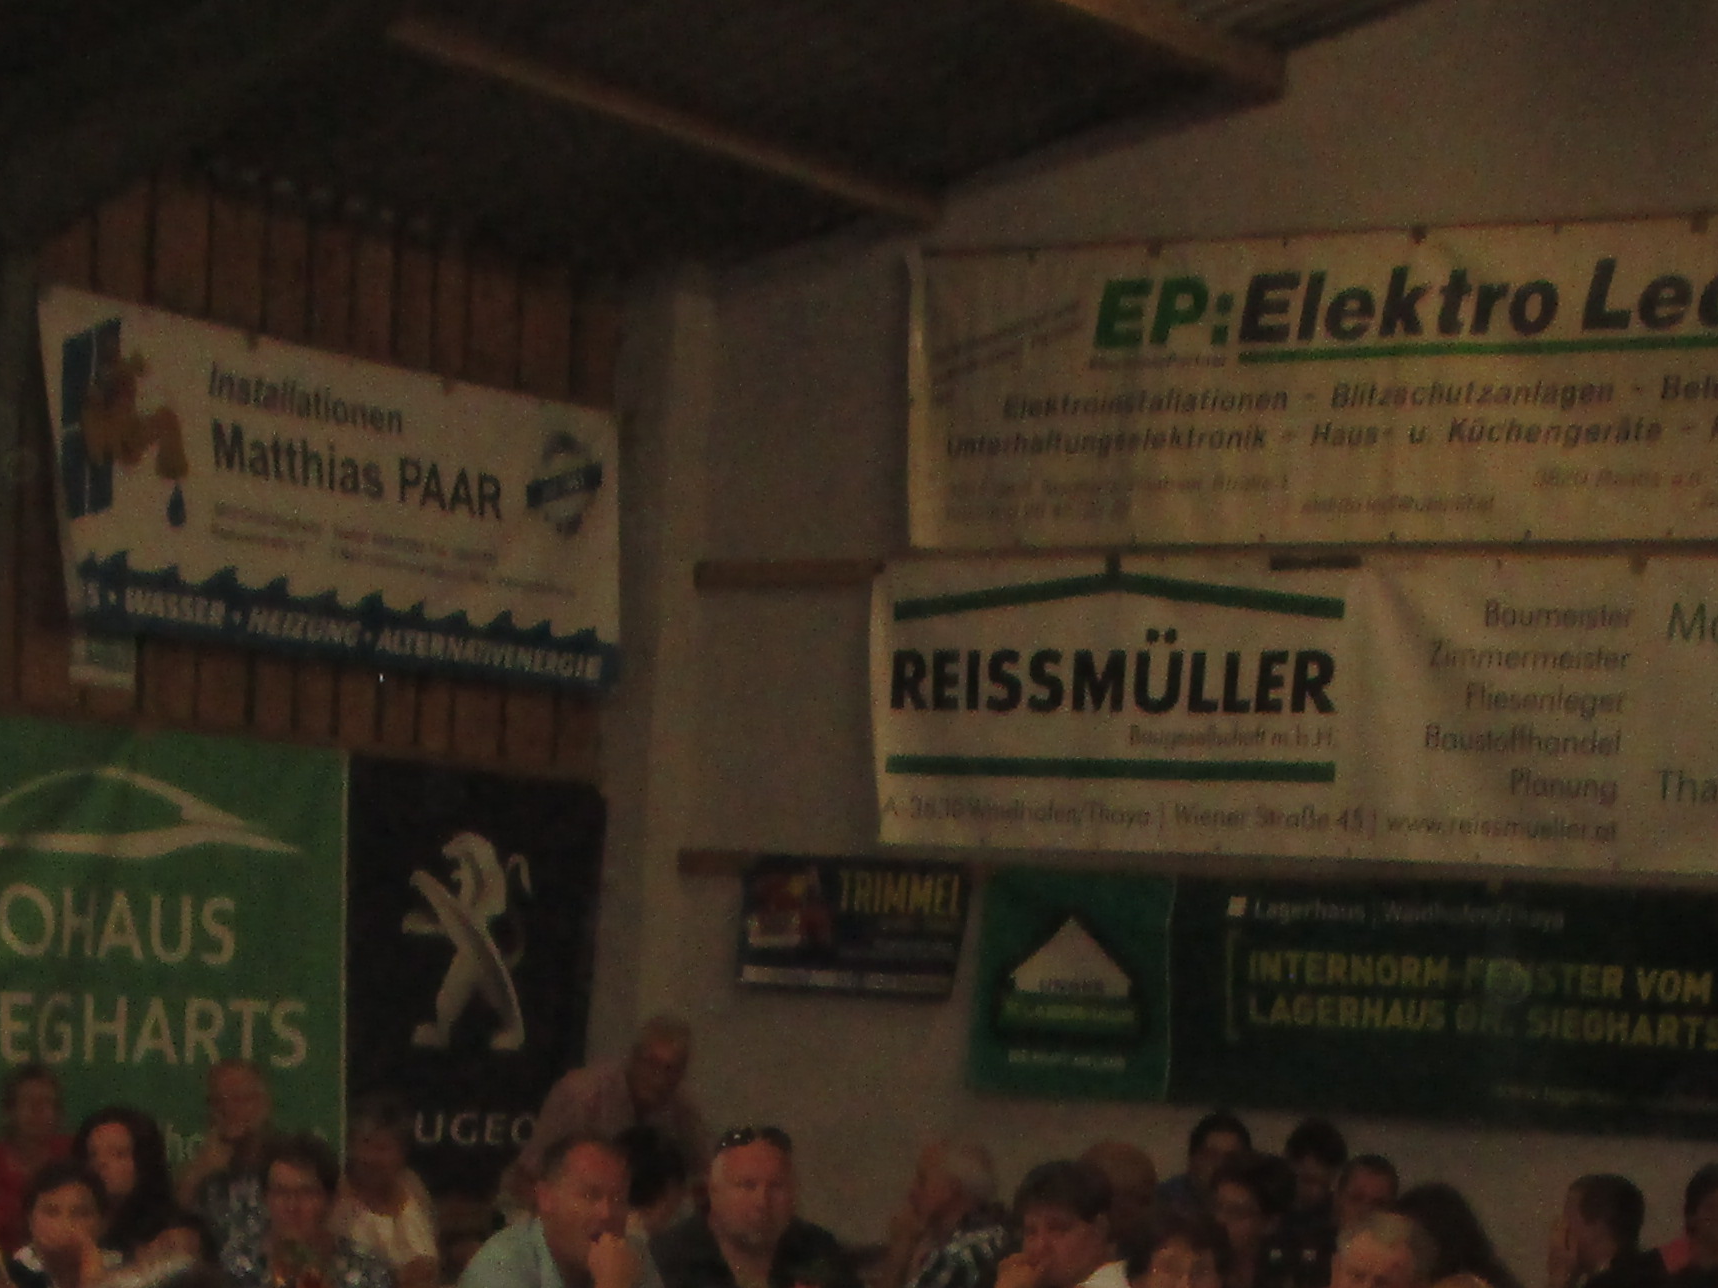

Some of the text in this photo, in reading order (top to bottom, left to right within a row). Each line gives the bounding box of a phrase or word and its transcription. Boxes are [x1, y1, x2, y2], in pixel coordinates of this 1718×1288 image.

[208, 359, 404, 435] Installationen
[1002, 387, 1290, 422] Elektroinstallationen
[1330, 379, 1615, 411] Blitzschutzanlagen
[1446, 417, 1664, 449] Küchengeräte
[211, 417, 385, 498] Matthias
[398, 456, 502, 519] PAAR
[122, 584, 227, 631] WASSER
[246, 601, 361, 649] HEIZUNG
[374, 624, 605, 683] ALTERNATIVENERGIE
[1483, 598, 1635, 631] Baumeister
[889, 626, 1337, 715] REISSMÜLLER
[1428, 639, 1631, 670] Zimmermeister
[1464, 681, 1626, 720] Fliesenleger
[1424, 723, 1623, 757] Baustoffhandel
[1508, 767, 1619, 807] Planung
[1174, 806, 1249, 829] Wiener
[838, 869, 962, 917] TRIMMEL
[1635, 967, 1714, 1008] VOM
[1247, 995, 1446, 1034] LAGERHAUS
